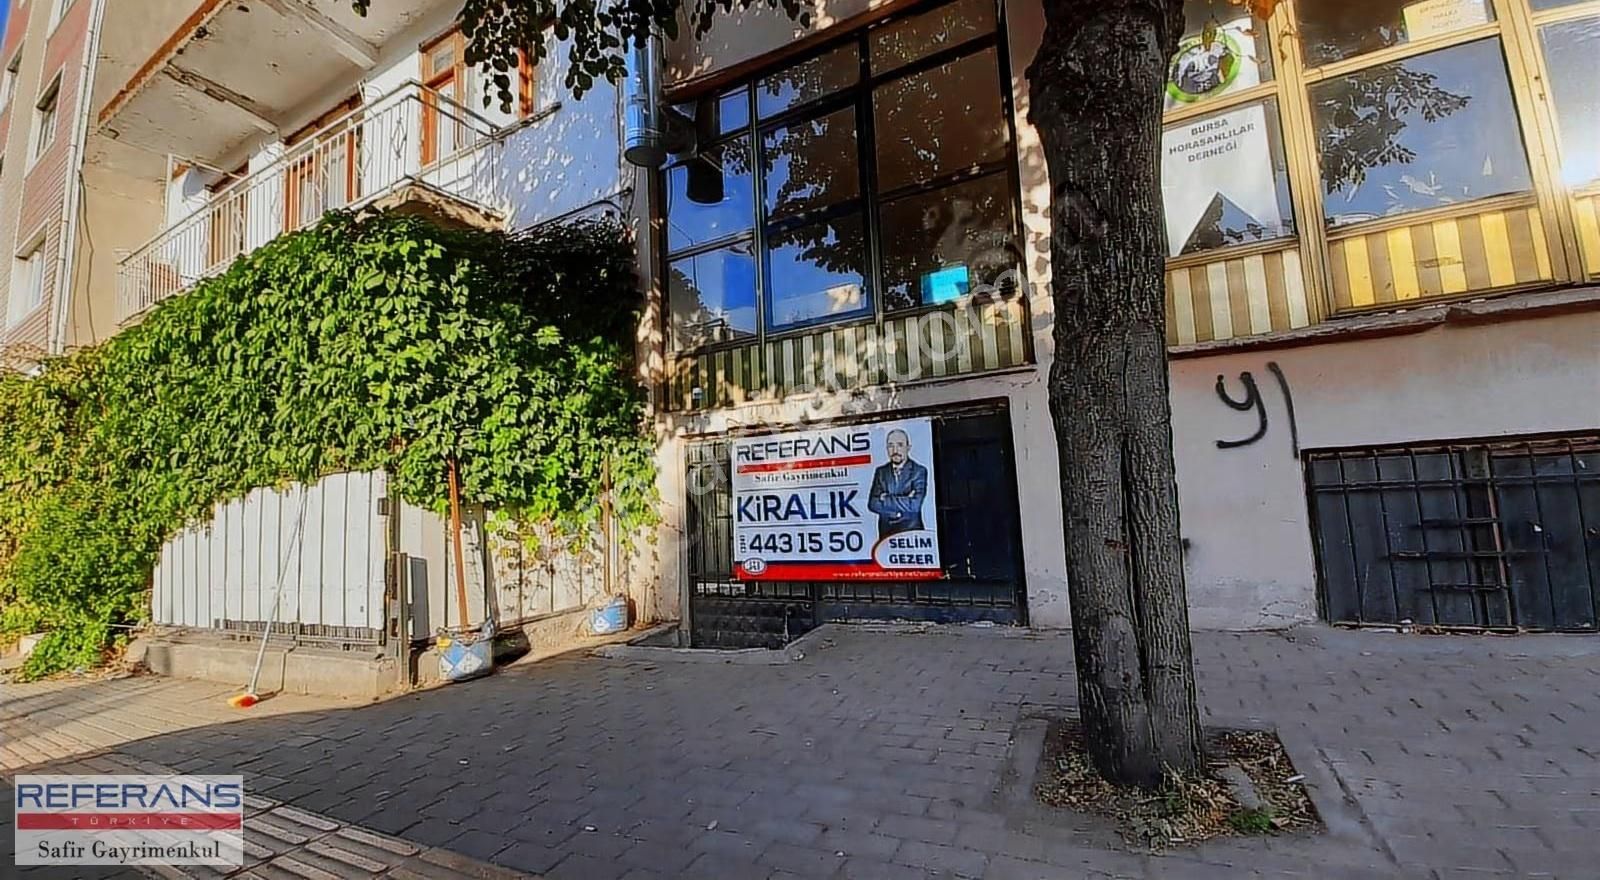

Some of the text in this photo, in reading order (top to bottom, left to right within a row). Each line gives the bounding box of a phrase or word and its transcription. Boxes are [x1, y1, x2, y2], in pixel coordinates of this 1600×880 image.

[1191, 118, 1229, 136] BURSA
[1168, 123, 1255, 155] HORASANLILAR
[736, 432, 871, 462] REFERANS
[754, 467, 849, 483] Safir Gayrimenkul
[749, 533, 793, 554] 443
[798, 532, 823, 553] 15
[829, 531, 864, 553] 50
[889, 535, 933, 549] SELİM
[889, 553, 934, 565] GEZER
